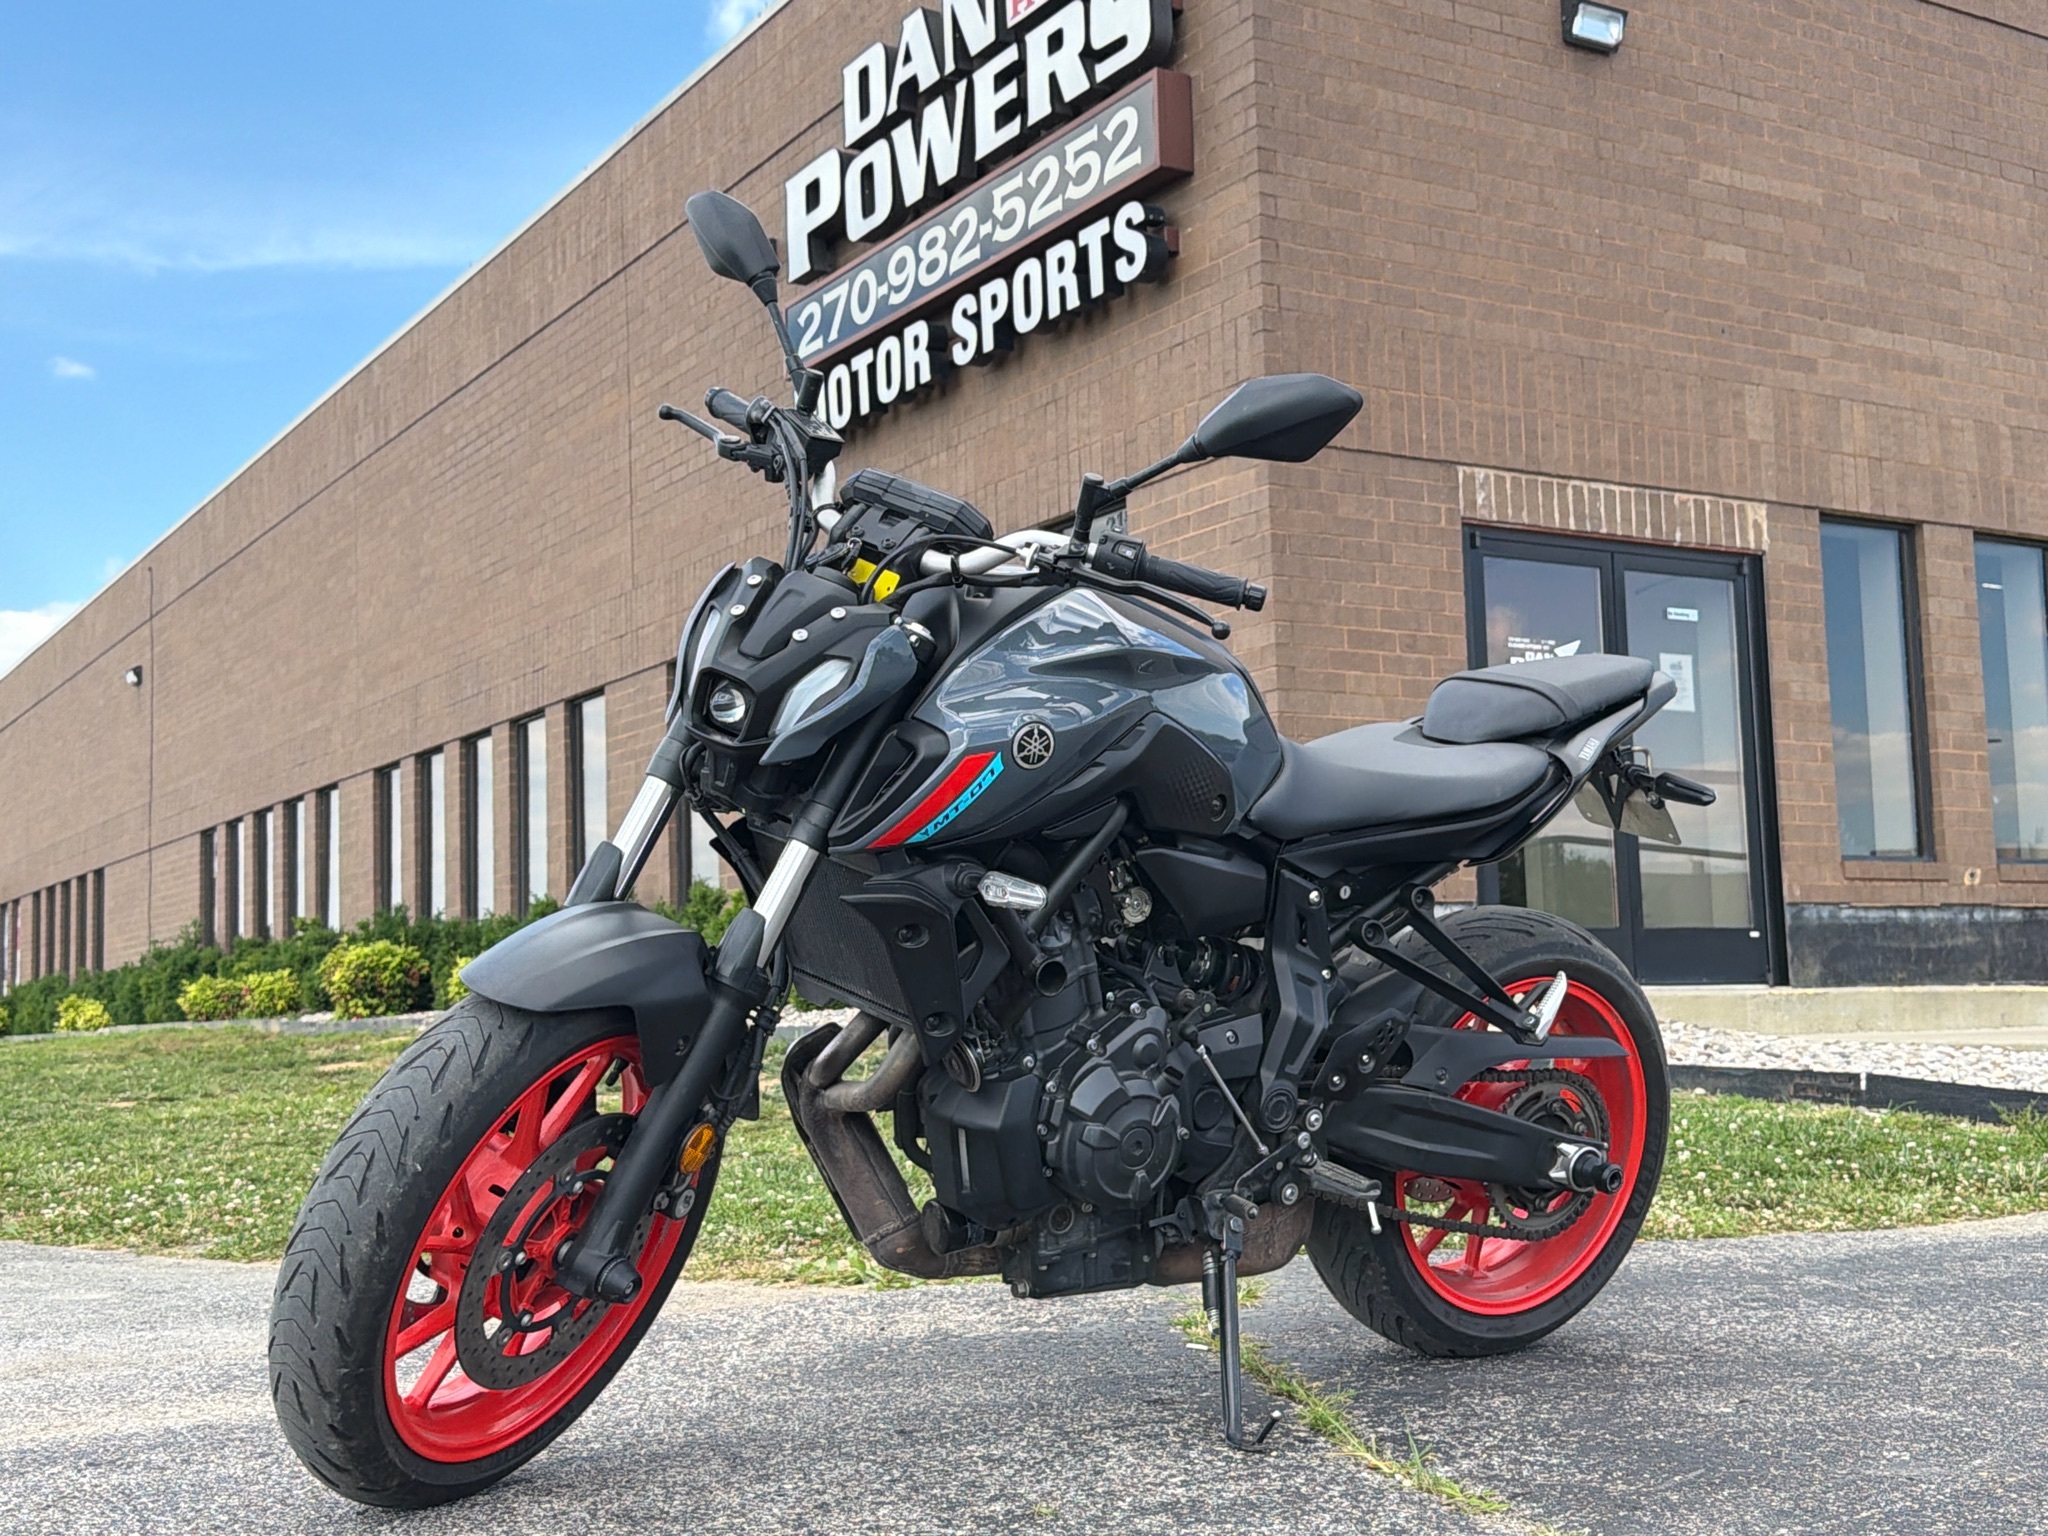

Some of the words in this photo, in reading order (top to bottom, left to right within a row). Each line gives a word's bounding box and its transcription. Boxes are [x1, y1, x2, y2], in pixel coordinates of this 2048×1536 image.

[785, 0, 1153, 284] POWERS
[843, 0, 997, 148] DAN
[797, 106, 1142, 359] 270-982-5252
[951, 201, 1147, 367] SPORTS
[933, 767, 996, 830] MT-07
